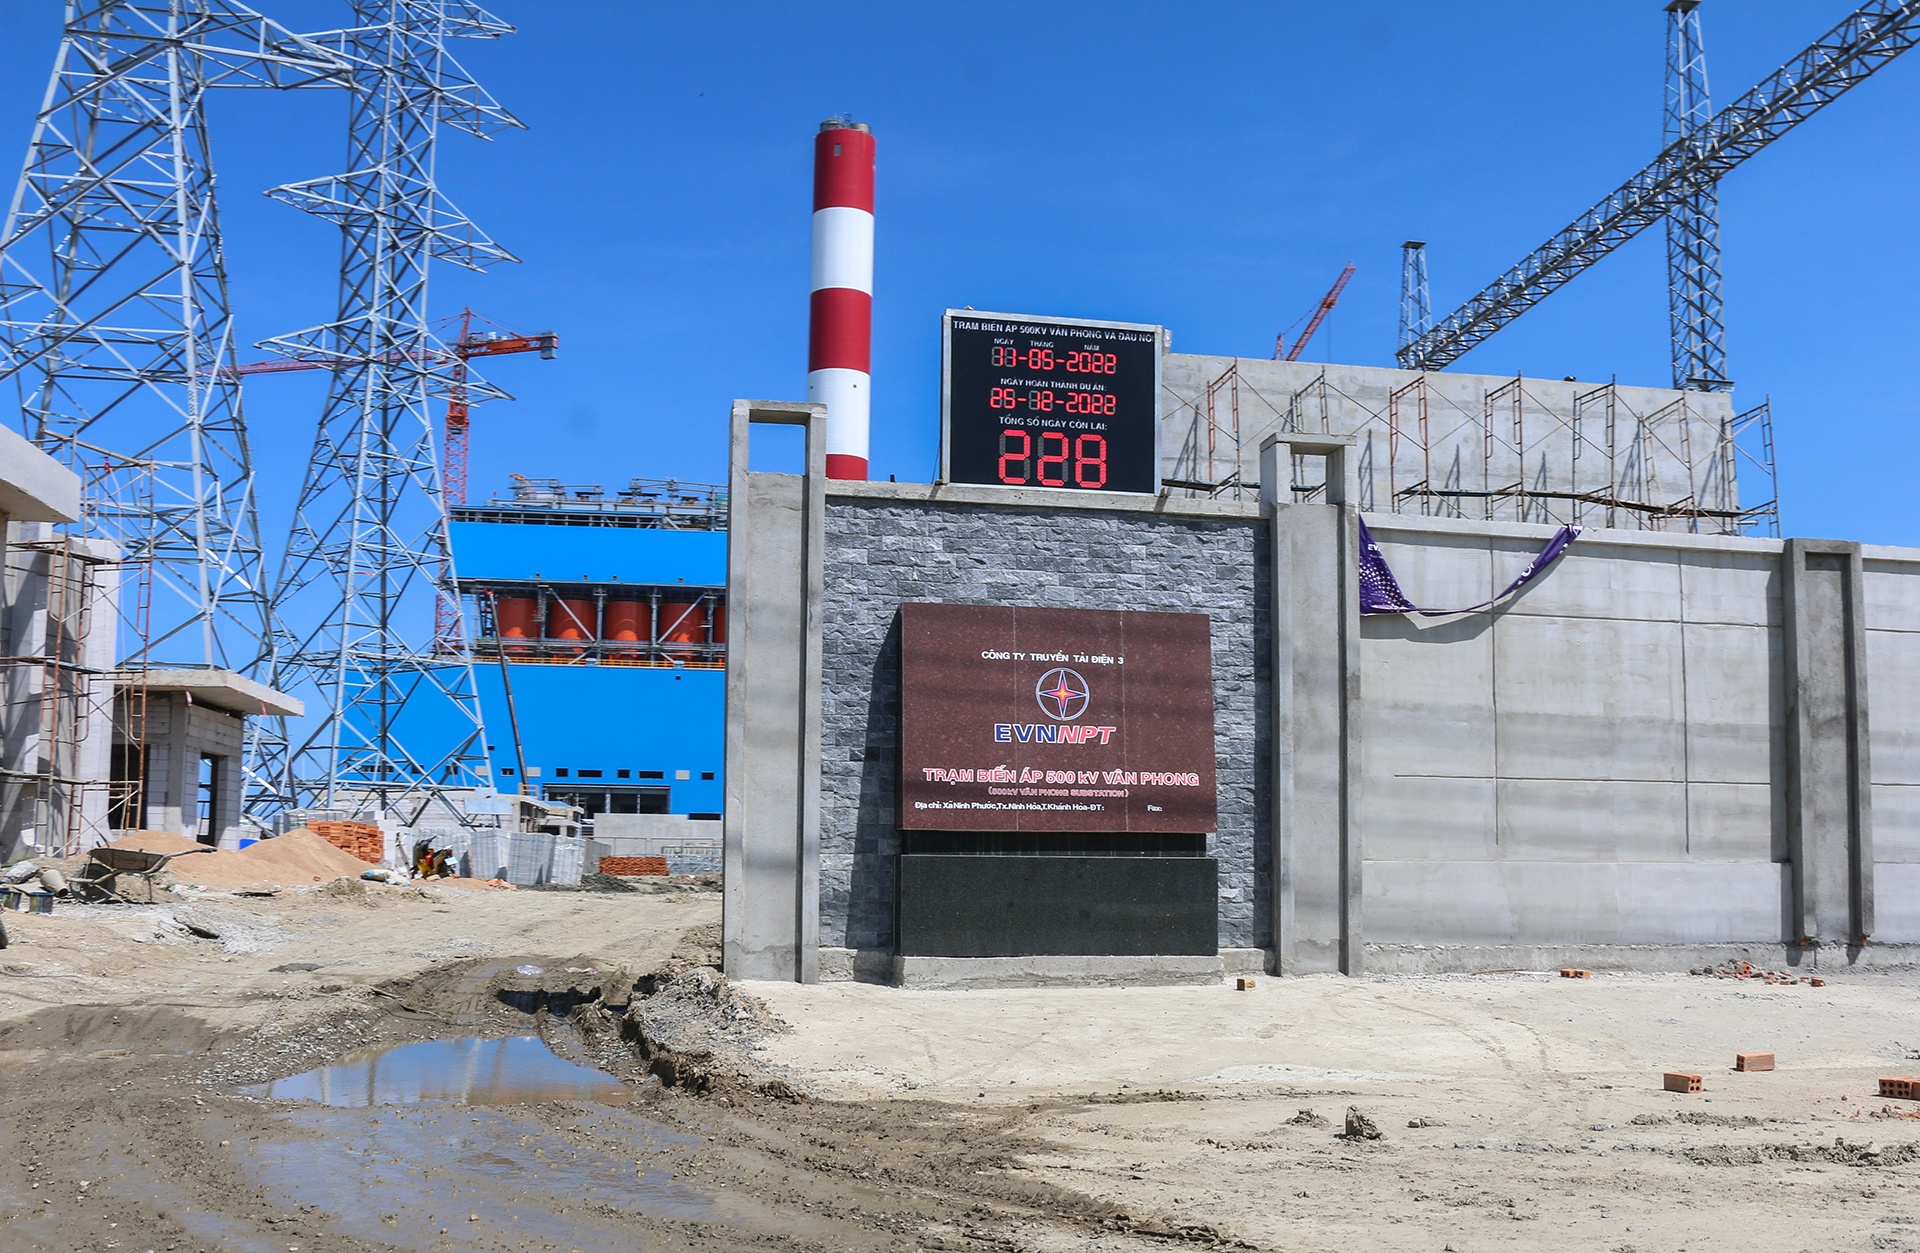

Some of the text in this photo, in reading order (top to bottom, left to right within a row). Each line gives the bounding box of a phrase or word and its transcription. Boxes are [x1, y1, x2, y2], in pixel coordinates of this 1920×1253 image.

[1020, 325, 1047, 335] 500KV
[1070, 329, 1102, 339] PHONG
[990, 387, 1117, 415] 25-12-2022
[999, 413, 1107, 431] TỔNG SỐ NGÀY CÒN LẠI:
[998, 429, 1107, 488] 228
[981, 648, 1124, 666] CÔNG TY TRUYỀN TẢI ĐIỆN 3
[994, 723, 1116, 744] EVNNPT
[922, 764, 1200, 787] TRẠM BIẾN ÁP 500 kV VÂN PHONG
[1019, 786, 1038, 796] VÂN
[1039, 788, 1069, 797] PHONG
[1070, 788, 1130, 798] SUBSTATION)
[914, 801, 928, 810] Địa
